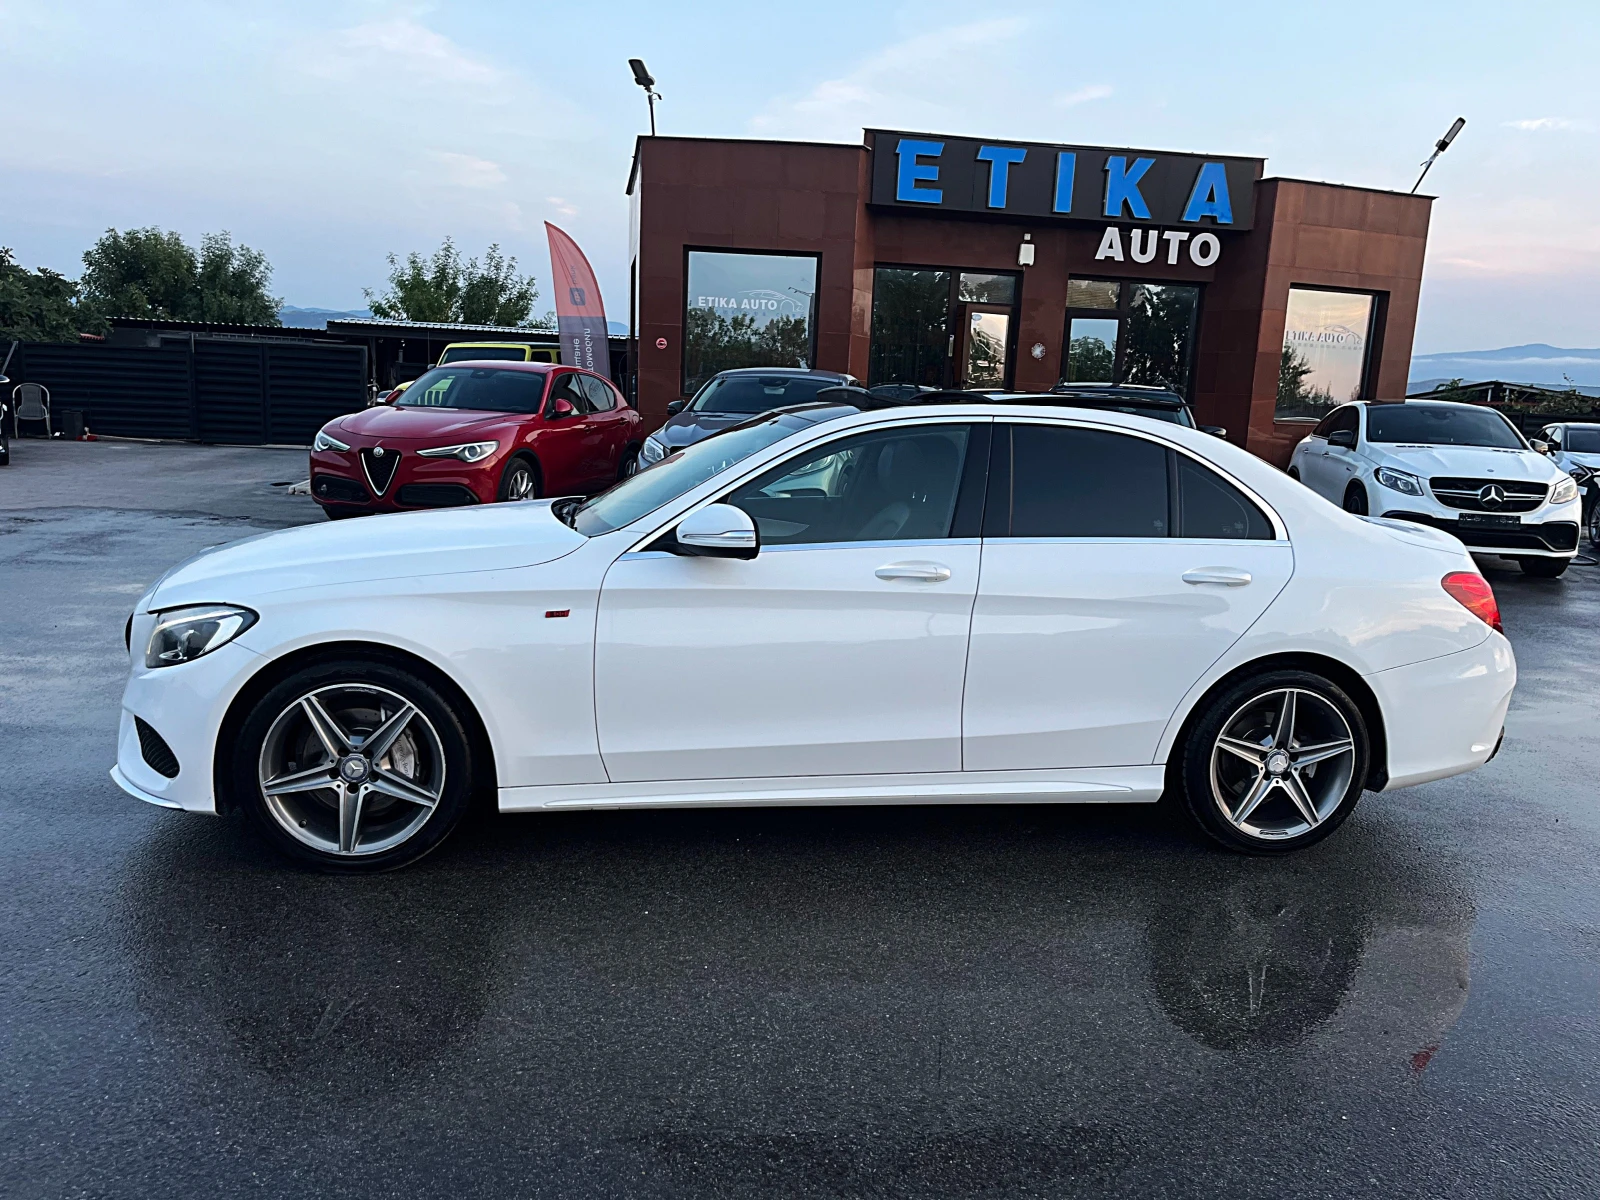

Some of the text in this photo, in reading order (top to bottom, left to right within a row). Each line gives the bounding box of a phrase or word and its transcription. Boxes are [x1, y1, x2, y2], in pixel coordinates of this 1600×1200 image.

[896, 139, 1234, 224] ETIKA
[1095, 226, 1221, 267] AUTO
[698, 296, 778, 311] ETIKA AUTO
[1317, 332, 1345, 344] AUTO
